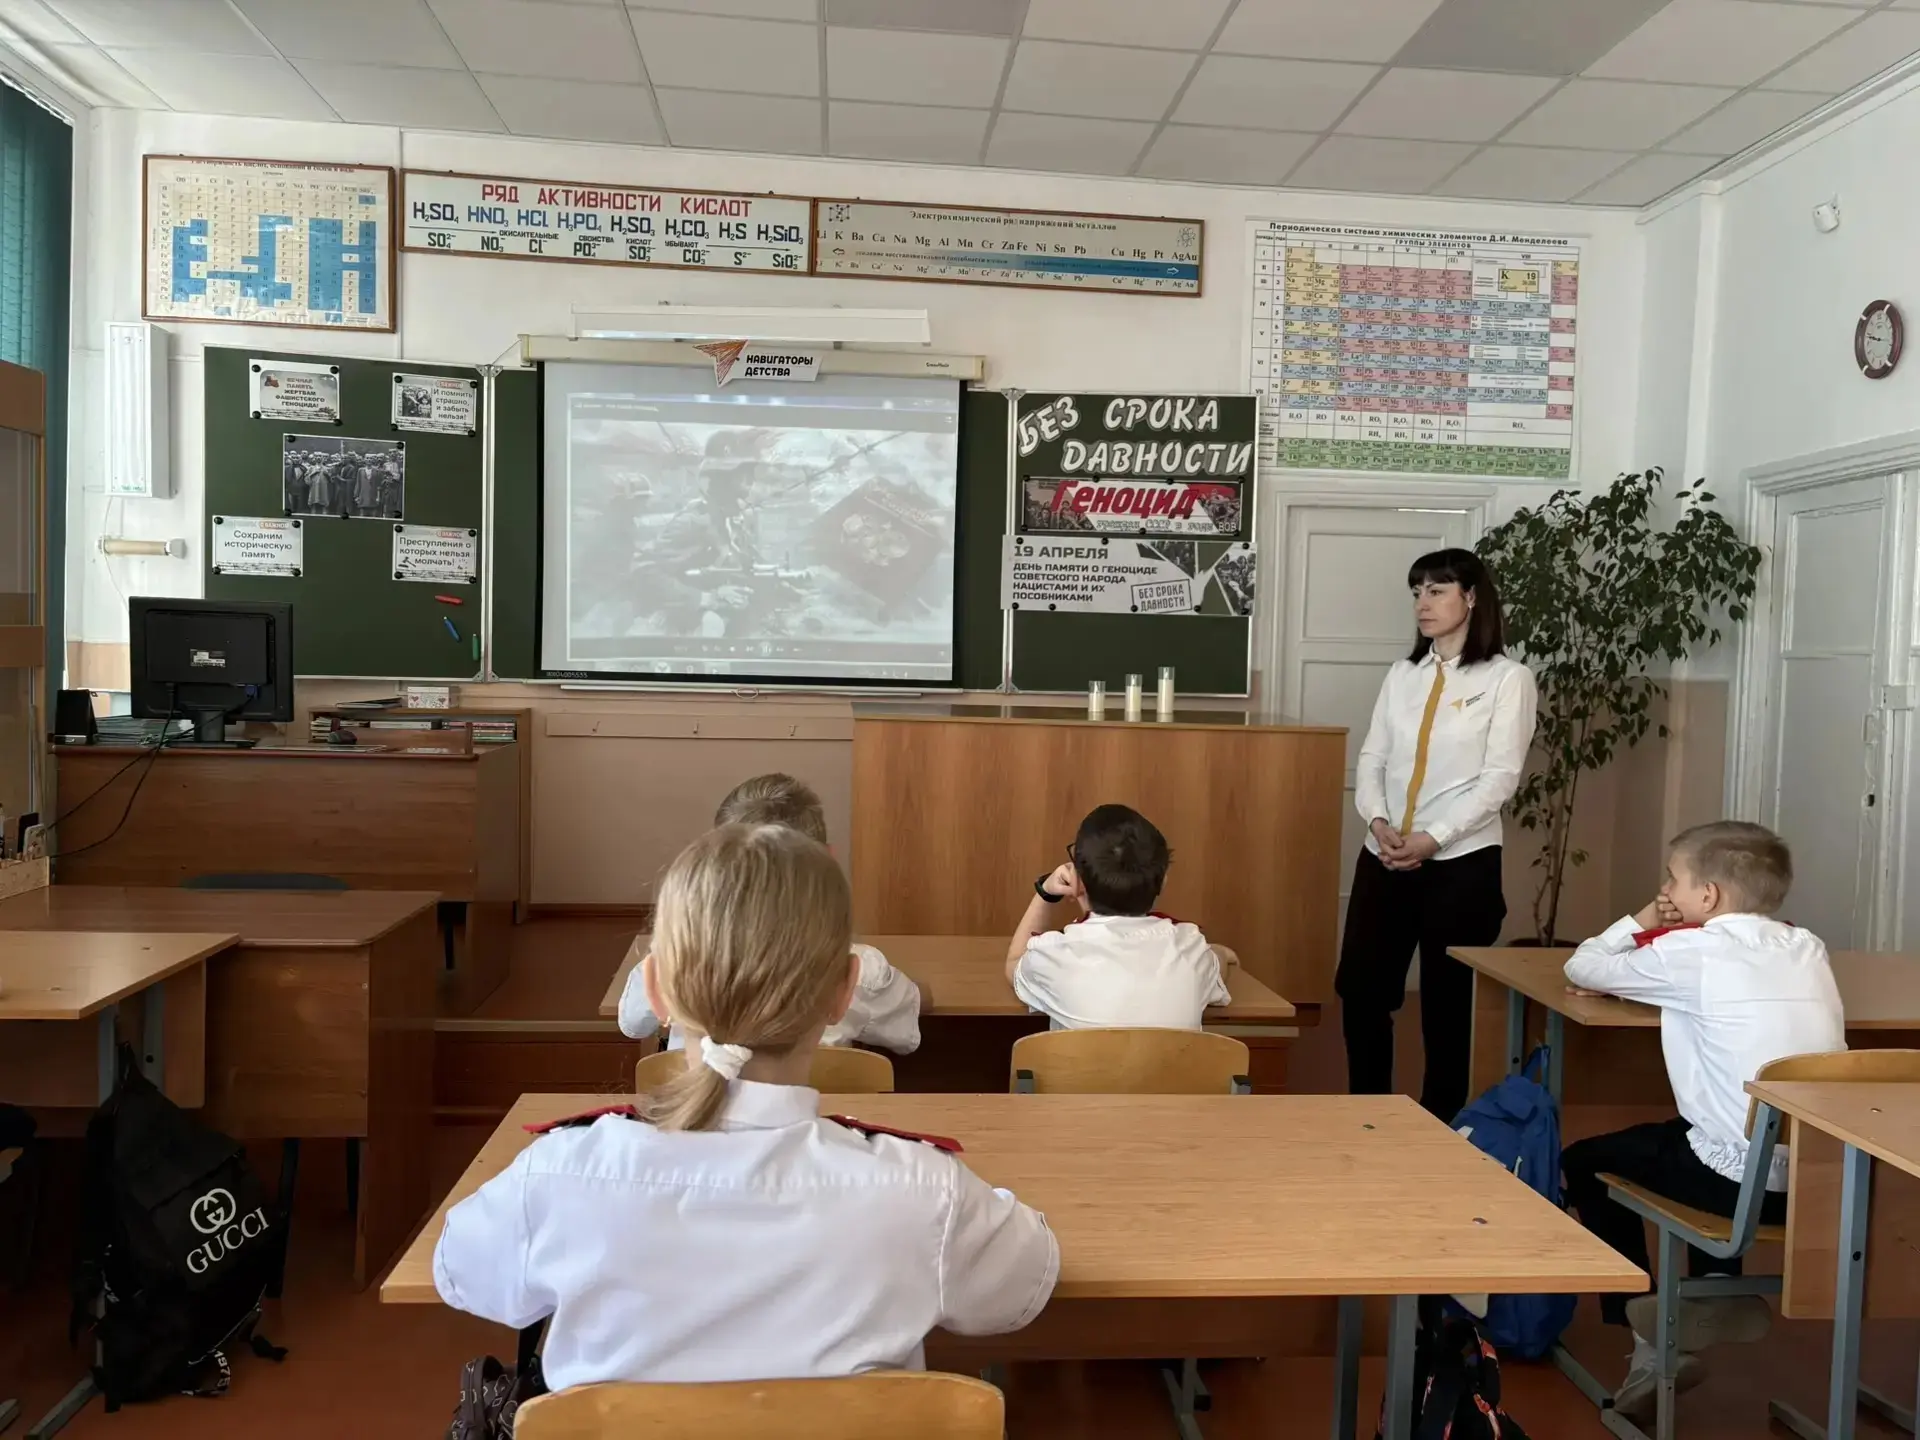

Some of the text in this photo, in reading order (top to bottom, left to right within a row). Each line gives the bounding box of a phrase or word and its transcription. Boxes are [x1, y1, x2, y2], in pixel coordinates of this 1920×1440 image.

[482, 183, 752, 218] РЯД АКТИВНОСТИ КИСЛОТ
[910, 210, 1002, 224] Электрохимический
[1269, 222, 1342, 233] Периодическая
[1344, 228, 1380, 236] система
[1382, 230, 1437, 239] химических
[1440, 233, 1487, 241] элементов
[1512, 236, 1568, 245] Менделеева
[626, 238, 652, 246] КИСЛОТ
[664, 240, 699, 249] УБЫВАЮТ
[852, 232, 864, 241] Ba
[872, 233, 886, 242] Ca
[893, 234, 907, 244] Na
[915, 236, 931, 247] Mg
[938, 238, 950, 246] Al
[958, 238, 974, 248] Mn
[981, 240, 994, 249] Cr
[1036, 242, 1047, 252] Ni
[1053, 244, 1066, 253] Sn
[1074, 245, 1087, 255] Pb
[1111, 247, 1125, 257] Cu
[1132, 249, 1147, 260] Hg
[1154, 250, 1164, 259] Pt
[1501, 270, 1536, 280] K 19
[746, 354, 813, 366] НАВИГАТОРЫ
[744, 366, 790, 378] ДЕТСТВА
[441, 390, 472, 398] помнить
[1018, 396, 1219, 455] БЕЗ СРОКА
[1062, 441, 1253, 474] ДАВНОСТИ
[1050, 480, 1200, 520] Геноцид
[233, 530, 283, 540] Сохраним
[224, 541, 292, 551] историческую
[399, 536, 464, 548] Преступления
[241, 551, 276, 559] память
[399, 548, 470, 558] которых нельзя
[1014, 546, 1108, 560] 19 АПРЕЛЯ
[414, 558, 455, 566] молчать!
[1013, 562, 1042, 572] ДЕНЬ
[1045, 564, 1089, 572] ПАМЯТИ
[1102, 565, 1158, 575] ГЕНОЦИДЕ
[1013, 572, 1126, 584] СОВЕТСКОГО НАРОДА
[1012, 582, 1078, 592] НАЦИСТАМИ
[1138, 584, 1184, 599] БЕЗ СРОКА
[1012, 592, 1093, 602] ПОСОБНИКАМИ
[1140, 596, 1185, 612] ДАВНОСТИ
[186, 1206, 270, 1274] GUCCI
